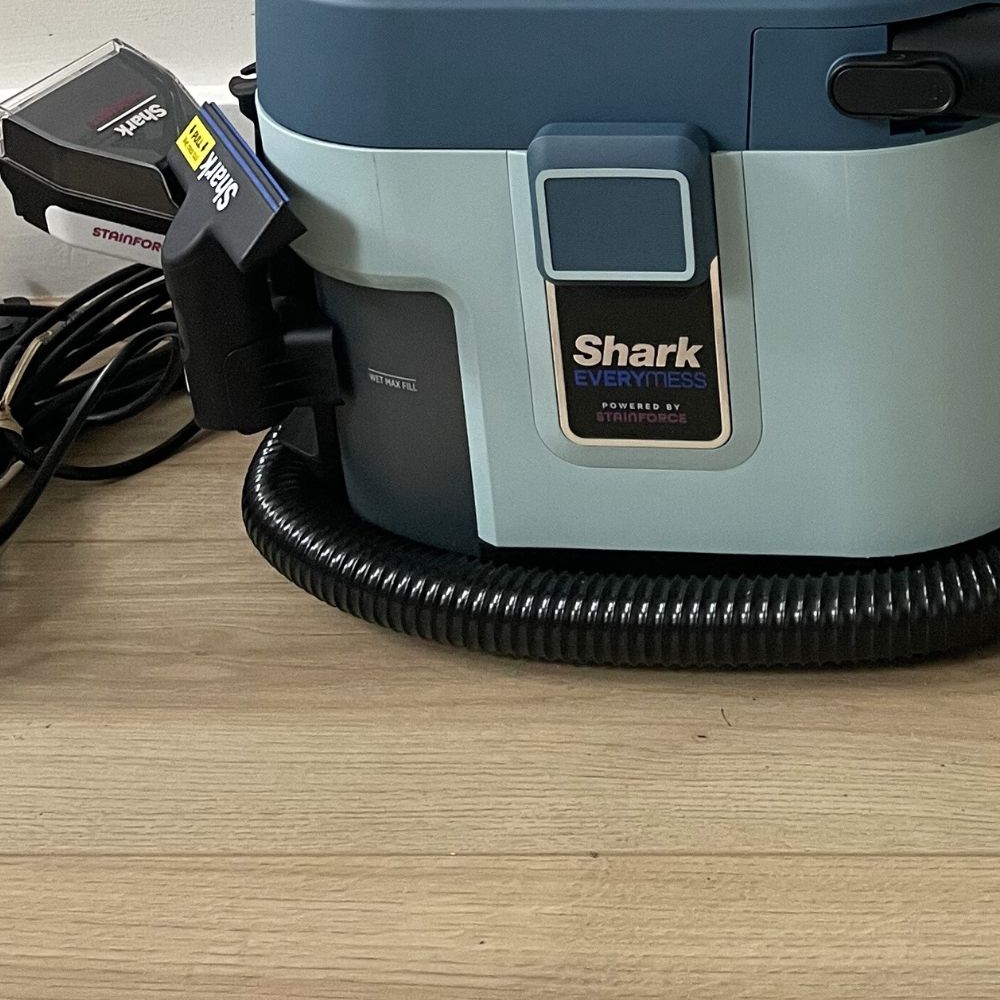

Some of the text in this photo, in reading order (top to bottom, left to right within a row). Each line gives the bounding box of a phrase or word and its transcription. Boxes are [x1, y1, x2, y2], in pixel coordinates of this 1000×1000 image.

[113, 104, 167, 136] Shark
[197, 151, 239, 211] Shark
[92, 227, 162, 252] STAINFOR
[573, 334, 704, 368] Shark
[368, 373, 418, 392] WET MAX FILL
[573, 369, 707, 389] EVERYMESS
[602, 401, 680, 411] POWERED BY
[595, 411, 687, 424] STAINFORCE
